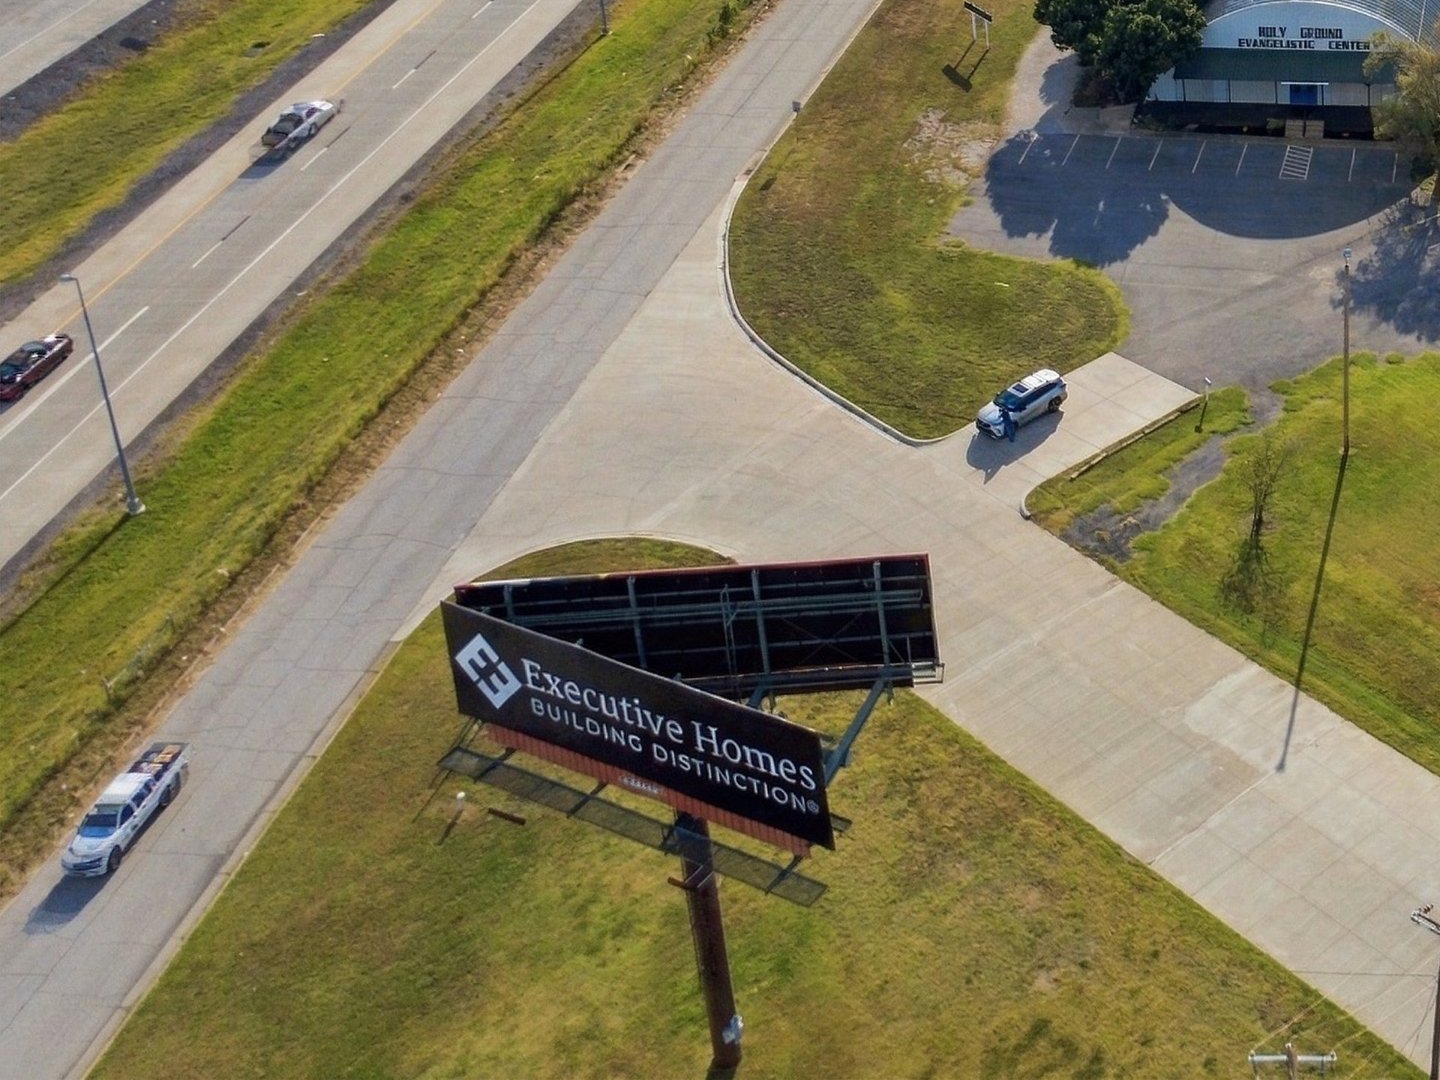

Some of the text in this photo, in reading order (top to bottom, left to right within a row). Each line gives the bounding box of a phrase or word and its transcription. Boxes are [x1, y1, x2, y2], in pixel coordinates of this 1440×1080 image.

[1238, 38, 1370, 50] EVANGELISTIC CENTER
[1258, 26, 1343, 39] HOLY GROUND
[521, 658, 816, 790] Executive Homes
[531, 698, 642, 752] BUILDING
